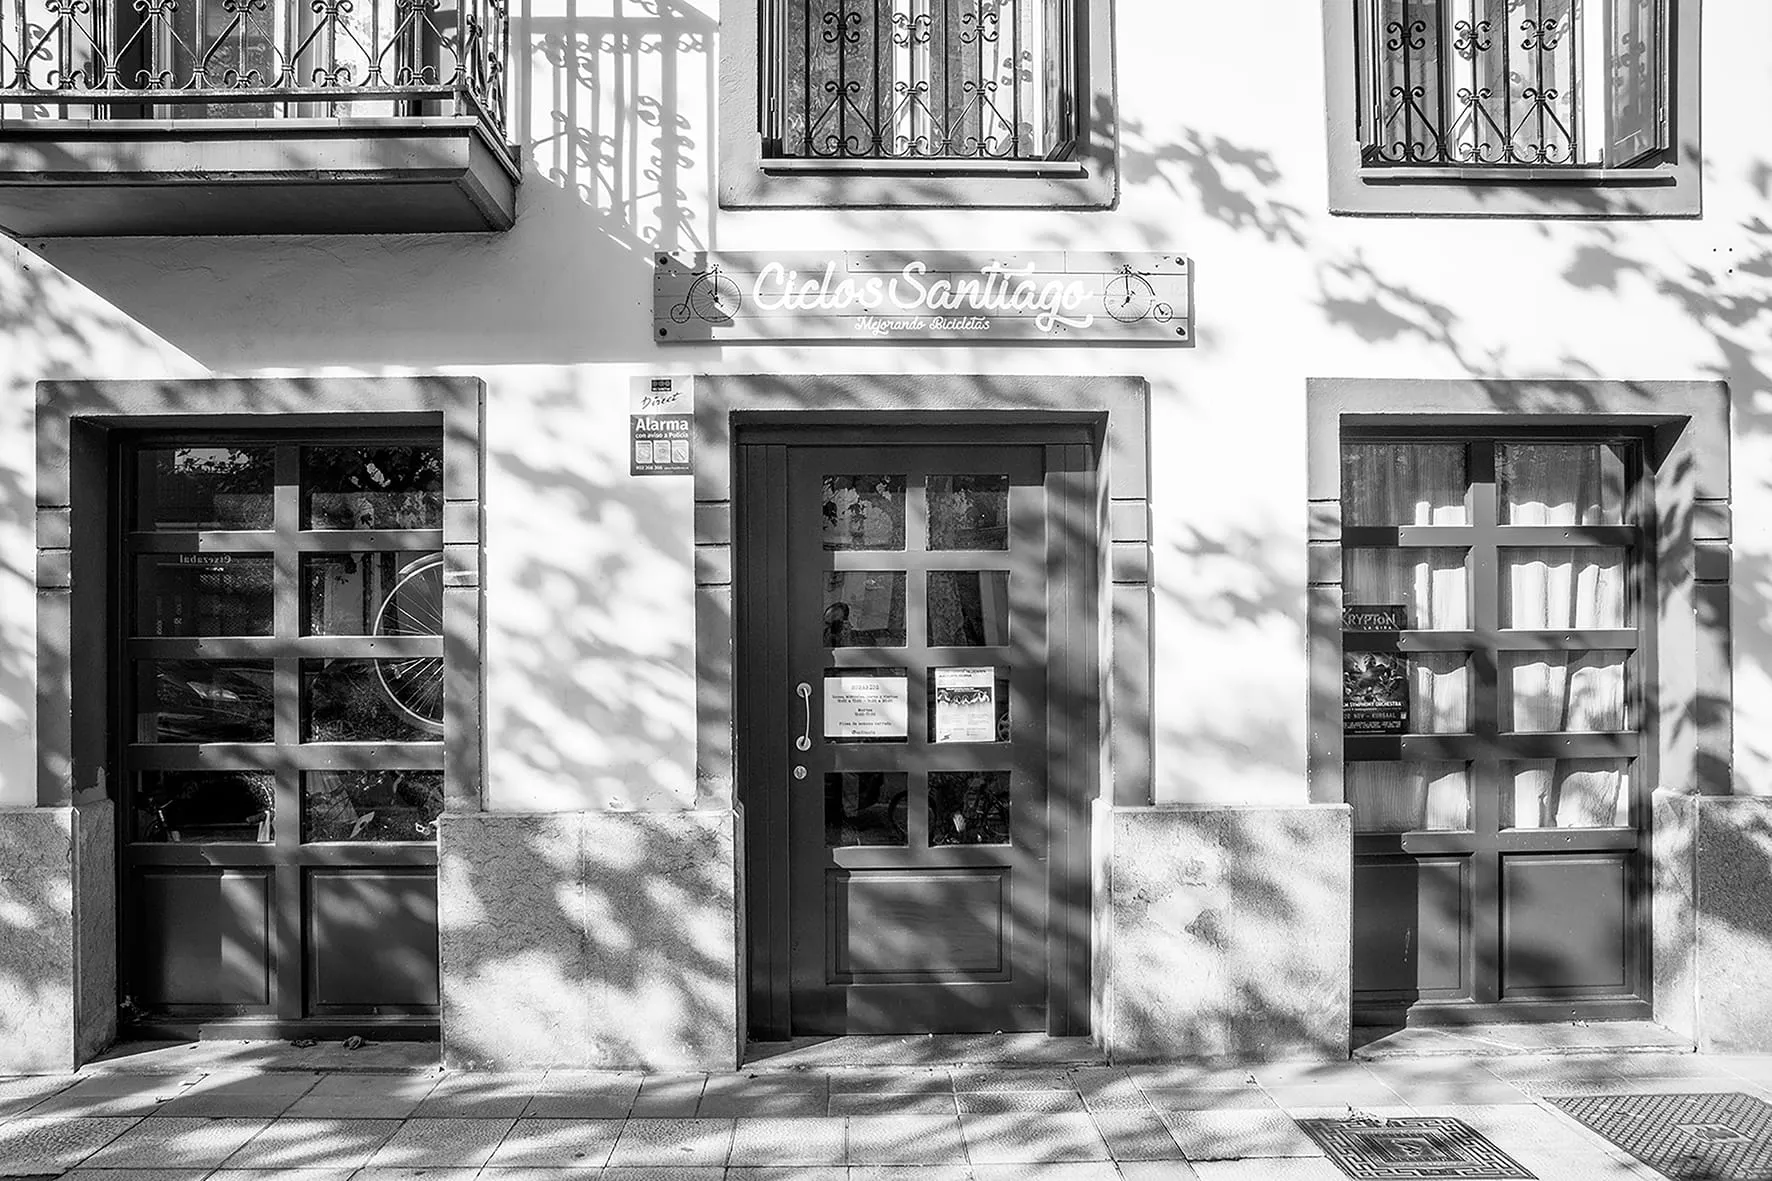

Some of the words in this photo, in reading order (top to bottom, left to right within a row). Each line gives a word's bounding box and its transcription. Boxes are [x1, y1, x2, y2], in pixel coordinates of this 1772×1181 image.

[753, 260, 884, 311] Ciclos
[889, 261, 1094, 332] Santiago
[854, 316, 926, 335] Mejorando
[929, 316, 990, 330] Bicicletas
[641, 392, 682, 410] Direct
[635, 417, 689, 431] Alarma
[1343, 607, 1398, 628] KRYPTON
